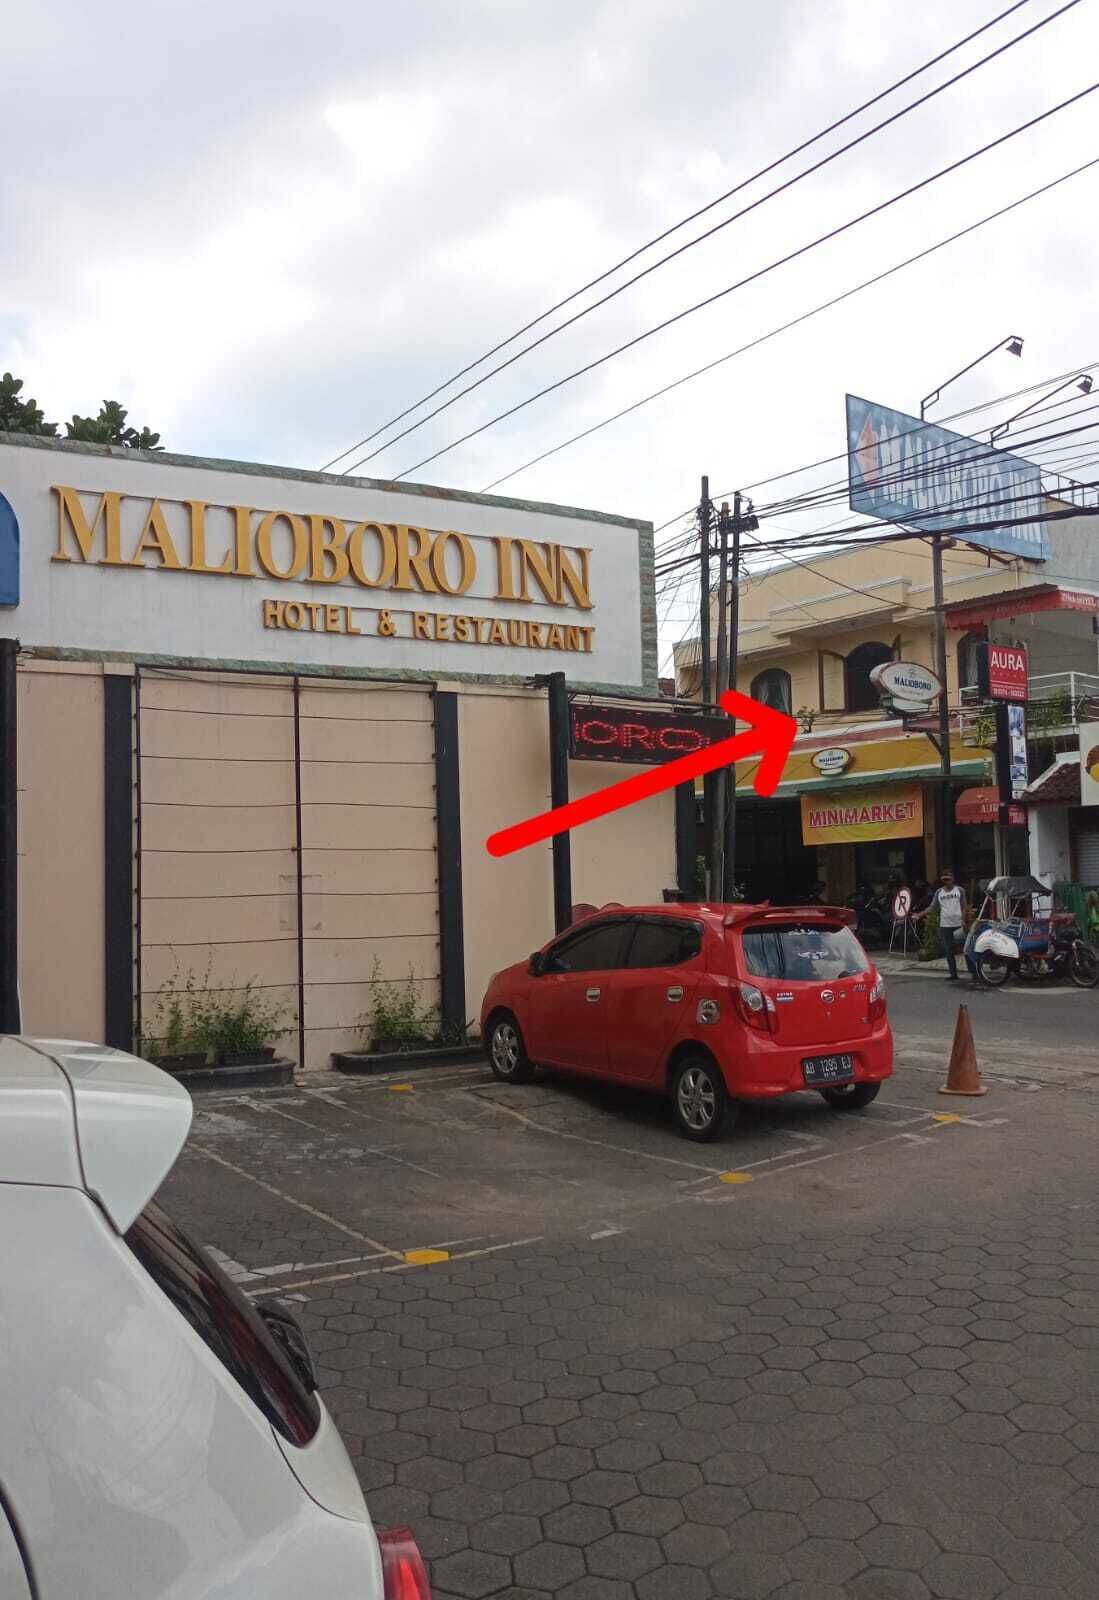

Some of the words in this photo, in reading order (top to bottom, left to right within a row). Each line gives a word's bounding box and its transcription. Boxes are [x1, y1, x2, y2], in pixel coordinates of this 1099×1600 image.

[51, 485, 477, 595] MALIOBORO
[492, 536, 594, 609] INN
[263, 599, 361, 635] HOTEL
[378, 608, 397, 637] &
[414, 611, 595, 653] RESTAURANT
[991, 651, 1025, 671] AURA
[894, 676, 932, 691] MALIOBORO
[808, 801, 917, 828] MINIMARKET
